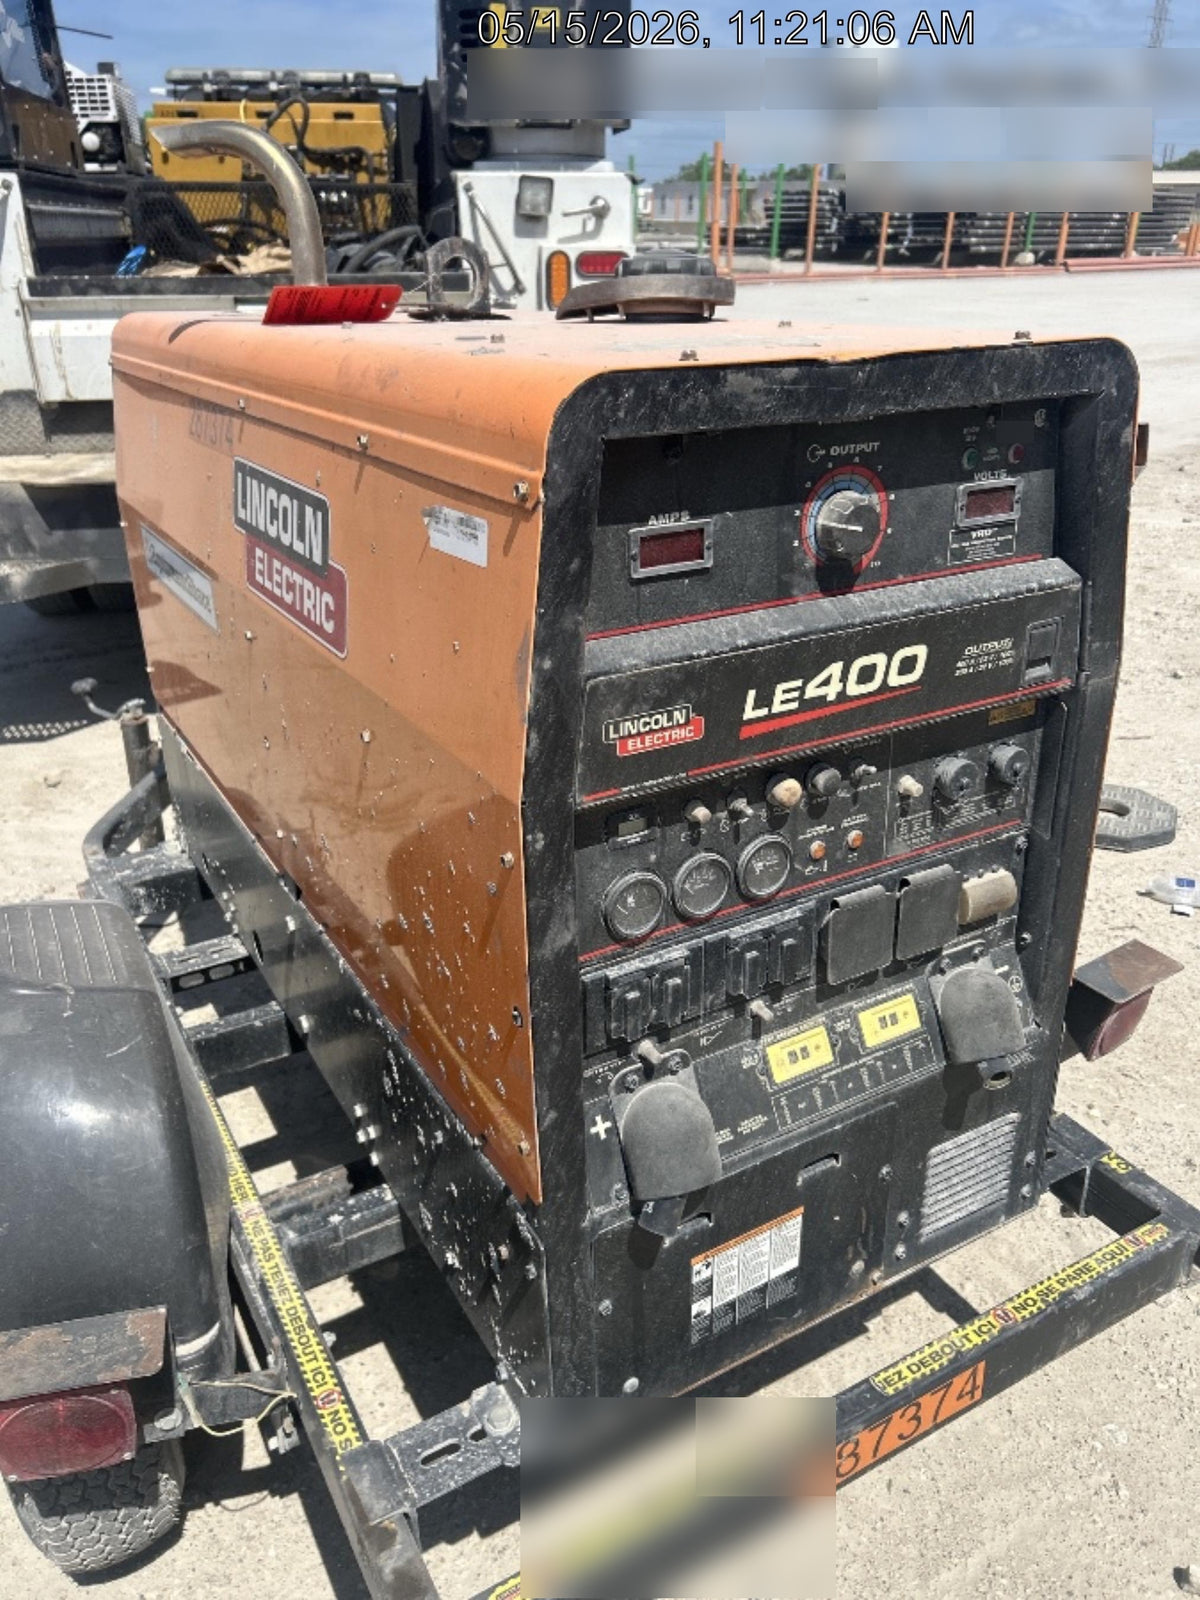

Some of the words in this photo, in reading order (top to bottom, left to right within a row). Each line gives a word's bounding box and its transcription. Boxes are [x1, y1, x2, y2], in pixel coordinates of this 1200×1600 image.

[829, 441, 881, 456] OUTPUT
[973, 468, 1008, 481] VOLTS
[236, 471, 324, 567] LINCOLN
[254, 546, 336, 635] ELECTRIC
[742, 643, 930, 721] LE400
[608, 708, 688, 740] LINCOLN
[627, 726, 696, 751] ELECTRIC
[255, 1237, 276, 1262] PAS
[285, 1305, 319, 1365] DEBOUT
[308, 1364, 329, 1388] ICI
[326, 1408, 348, 1436] NO
[905, 1329, 974, 1377] DEBOUT
[971, 1318, 997, 1338] ICI
[1012, 1294, 1038, 1315] NO
[1037, 1281, 1060, 1300] SE
[1058, 1261, 1097, 1289] PARE
[1095, 1243, 1130, 1268] AQUI
